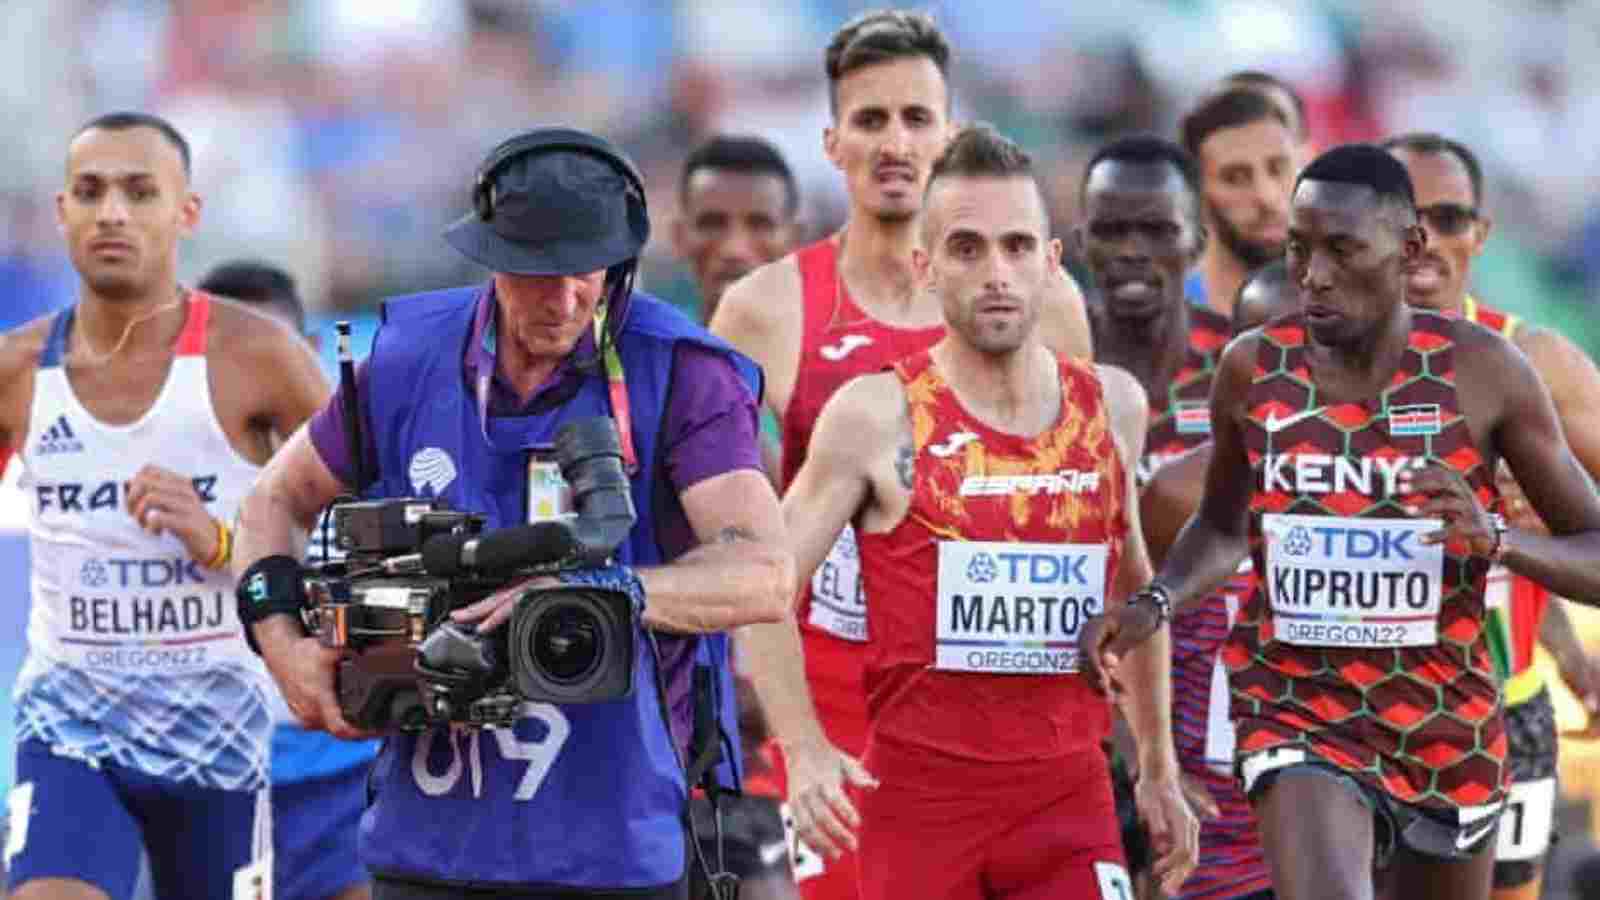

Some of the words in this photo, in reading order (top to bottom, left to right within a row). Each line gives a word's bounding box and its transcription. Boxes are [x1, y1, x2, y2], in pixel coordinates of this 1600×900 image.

[1313, 528, 1416, 559] TDK
[108, 558, 207, 588] TDK
[998, 554, 1088, 584] TDK
[1274, 566, 1431, 608] KIPRUTO
[69, 592, 224, 633] BELHADJ
[1287, 623, 1407, 643] OREGON22
[85, 648, 208, 667] OREGON22
